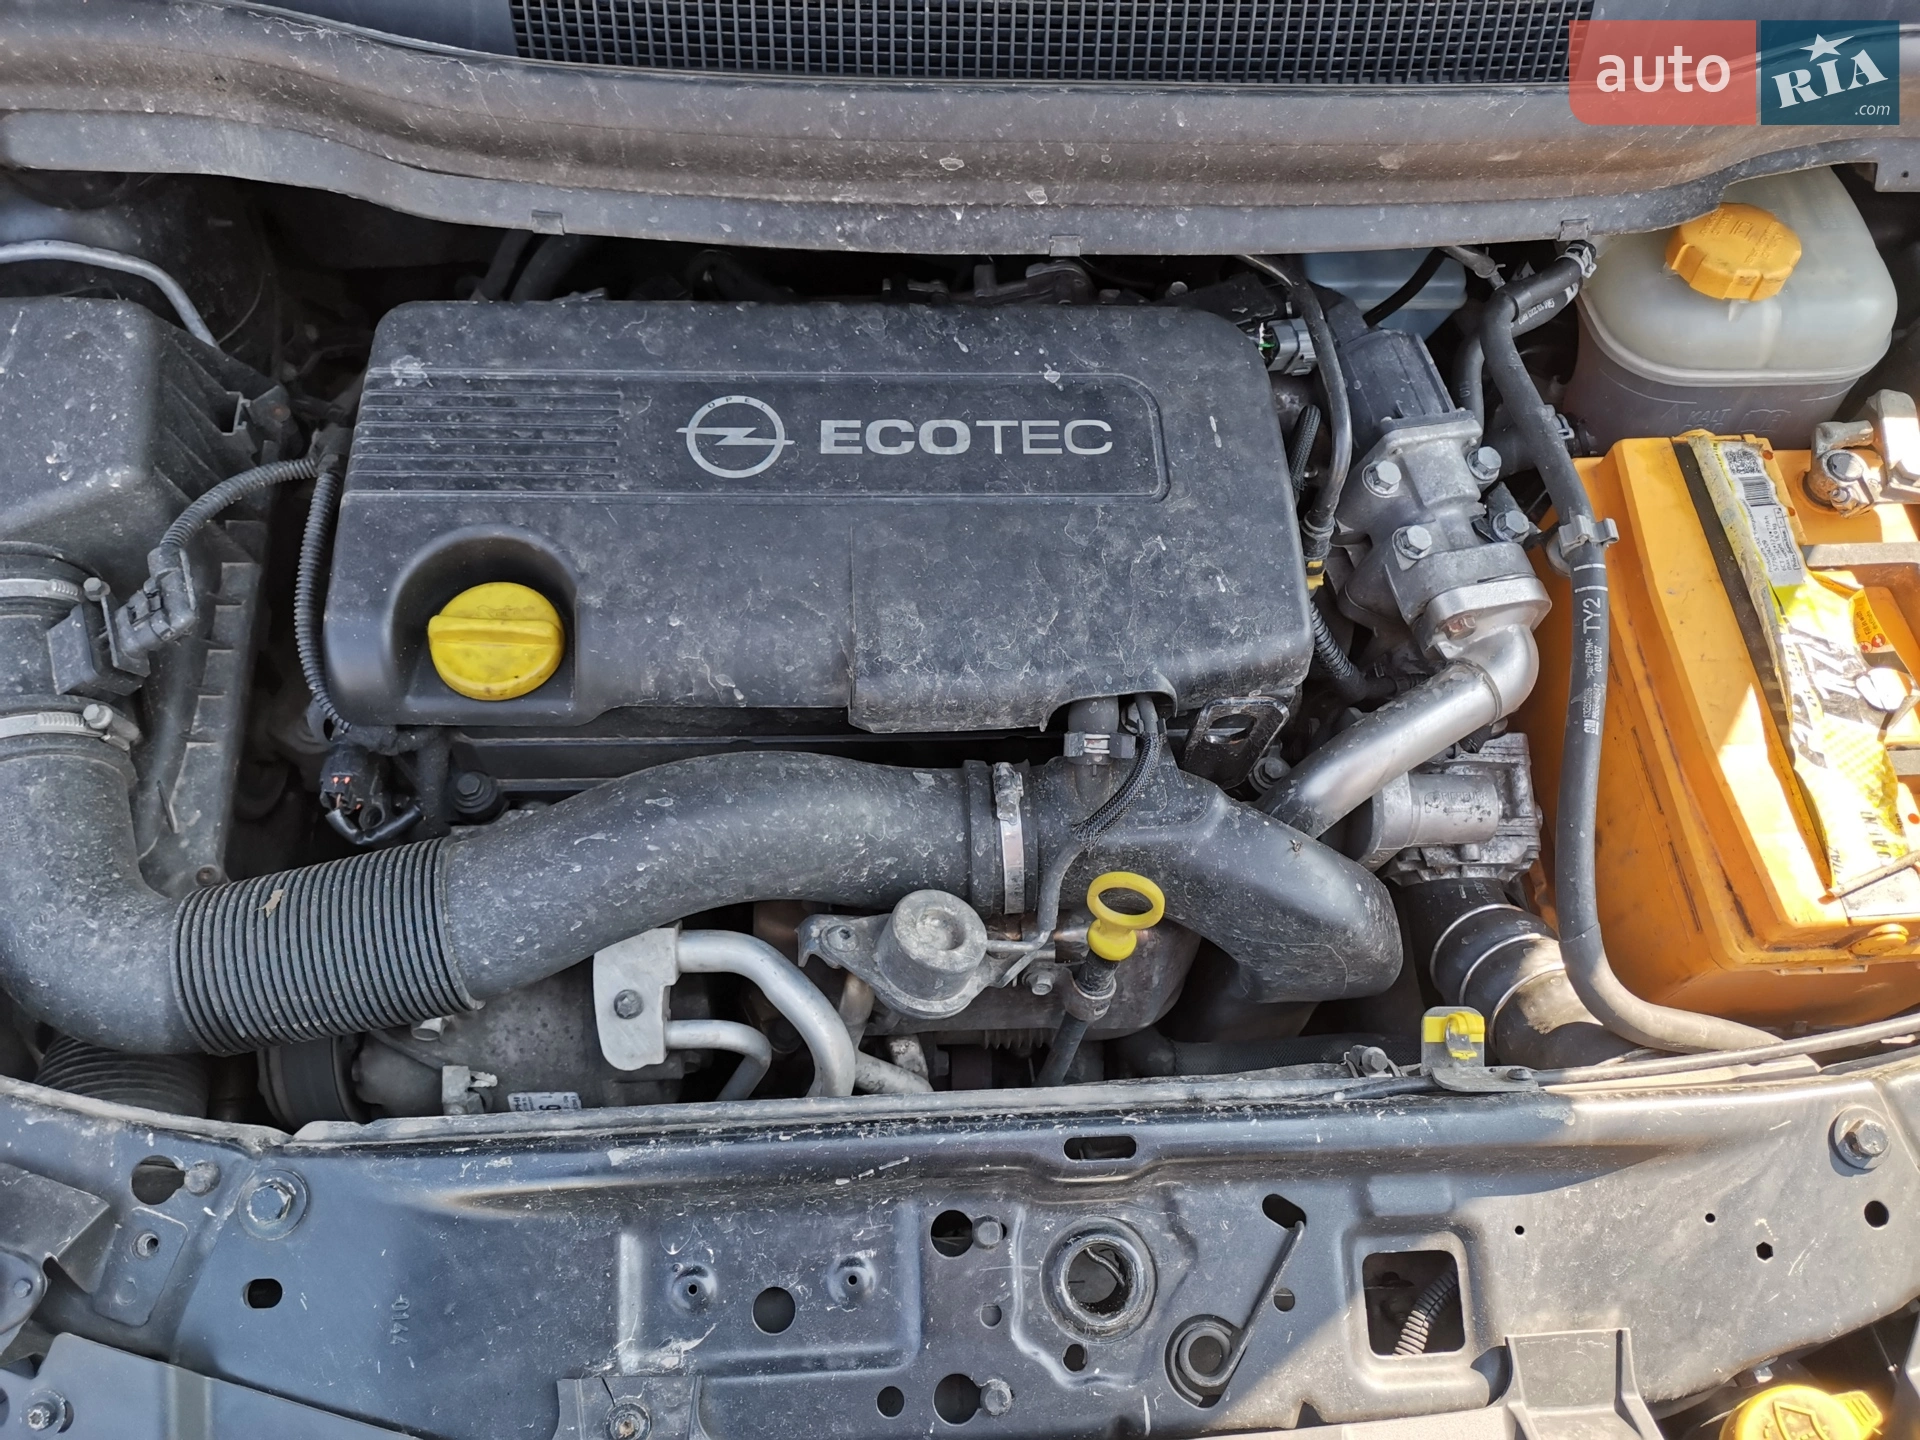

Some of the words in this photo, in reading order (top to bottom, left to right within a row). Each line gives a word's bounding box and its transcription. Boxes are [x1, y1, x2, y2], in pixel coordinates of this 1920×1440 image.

[707, 397, 766, 410] OPEL
[820, 419, 1113, 455] ECOTEC
[1582, 597, 1601, 634] TY2
